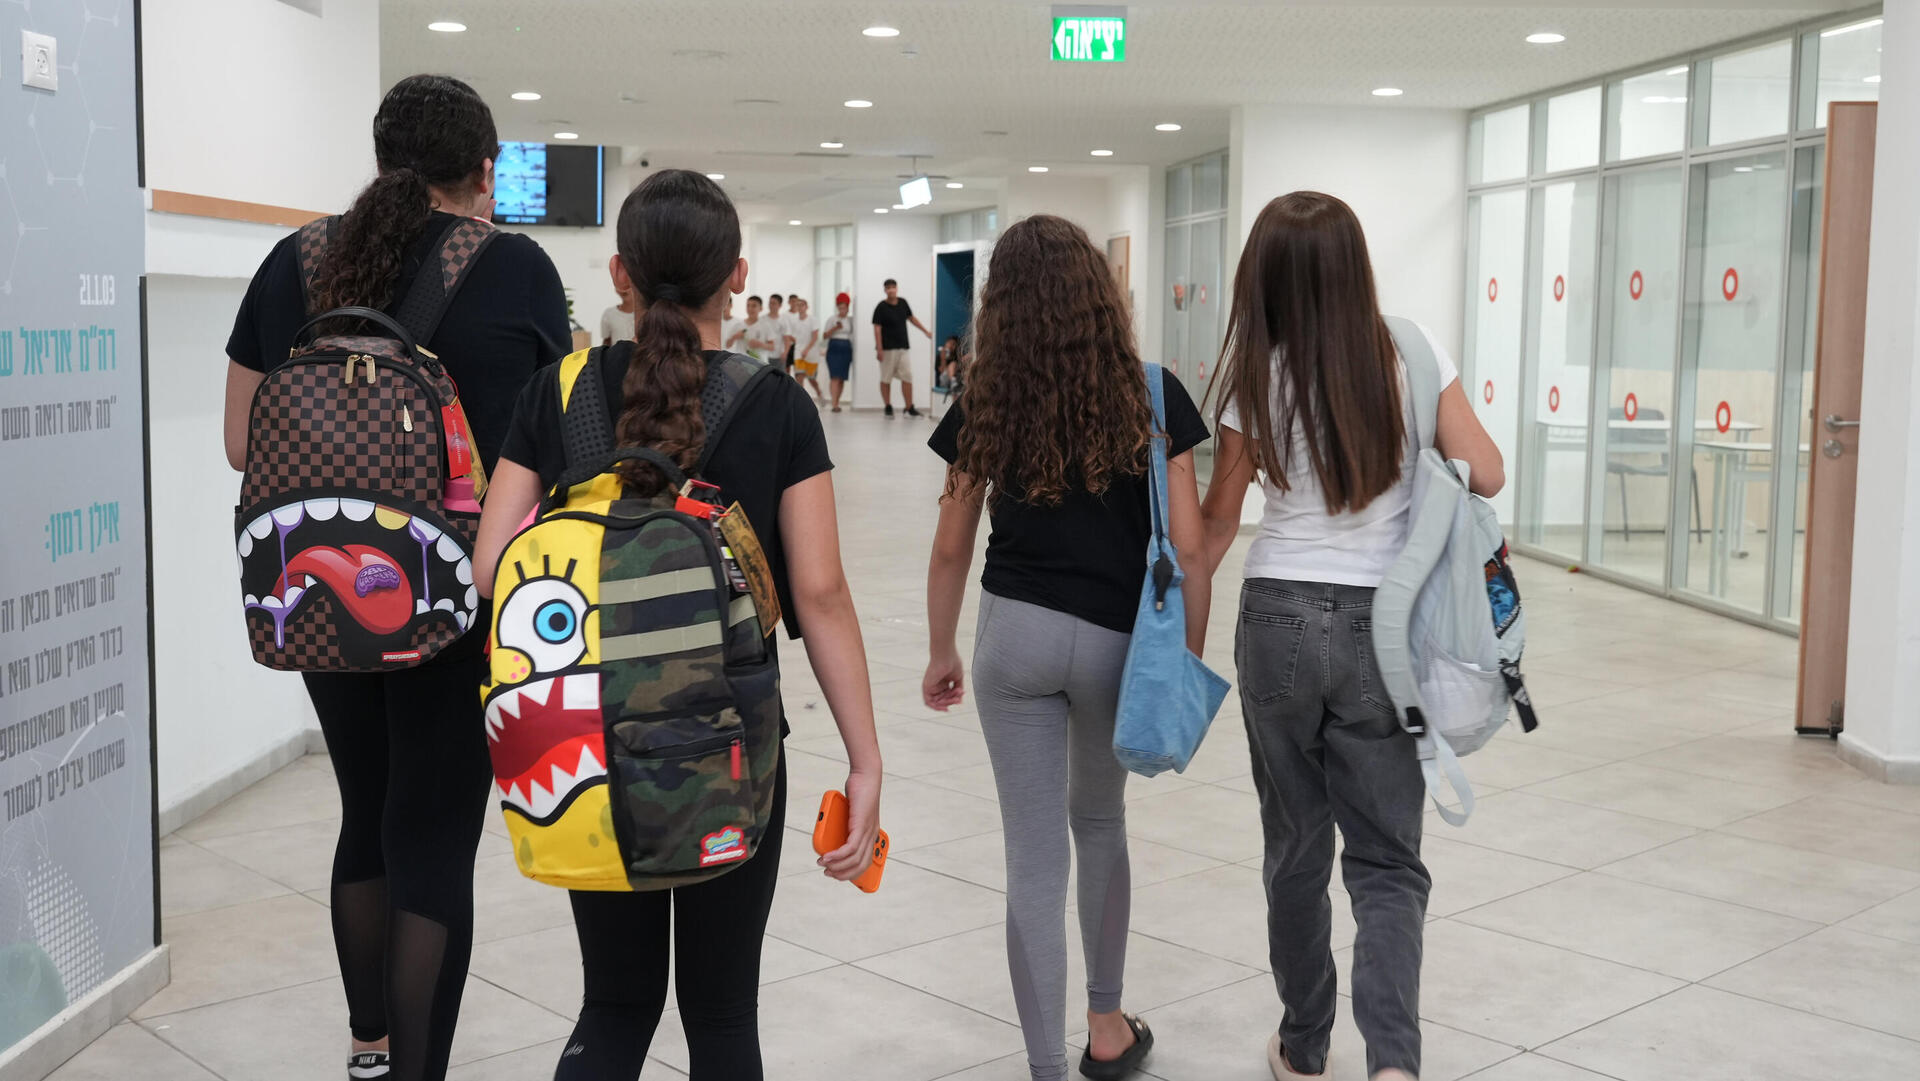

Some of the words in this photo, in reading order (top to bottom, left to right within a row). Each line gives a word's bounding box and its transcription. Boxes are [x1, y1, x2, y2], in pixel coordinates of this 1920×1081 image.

[1065, 20, 1123, 60] יציאה
[79, 273, 115, 305] 21.1.03
[20, 326, 72, 375] אריאל
[35, 403, 63, 437] רואה
[67, 401, 92, 433] אתה
[45, 508, 82, 563] רמון:
[89, 501, 120, 554] אילן
[1, 598, 15, 633] זה
[20, 589, 50, 632] מכאן
[54, 576, 96, 617] שרואים
[66, 635, 95, 678] הארץ
[100, 626, 123, 661] כדור
[8, 656, 31, 695] הוא
[35, 646, 62, 685] שלנו
[70, 695, 89, 732] הוא
[94, 682, 124, 726] מעניין
[47, 756, 84, 802] צריכים
[87, 738, 125, 783] שאנחנו
[3, 774, 42, 822] לשמור
[359, 1055, 377, 1065] NIKE
